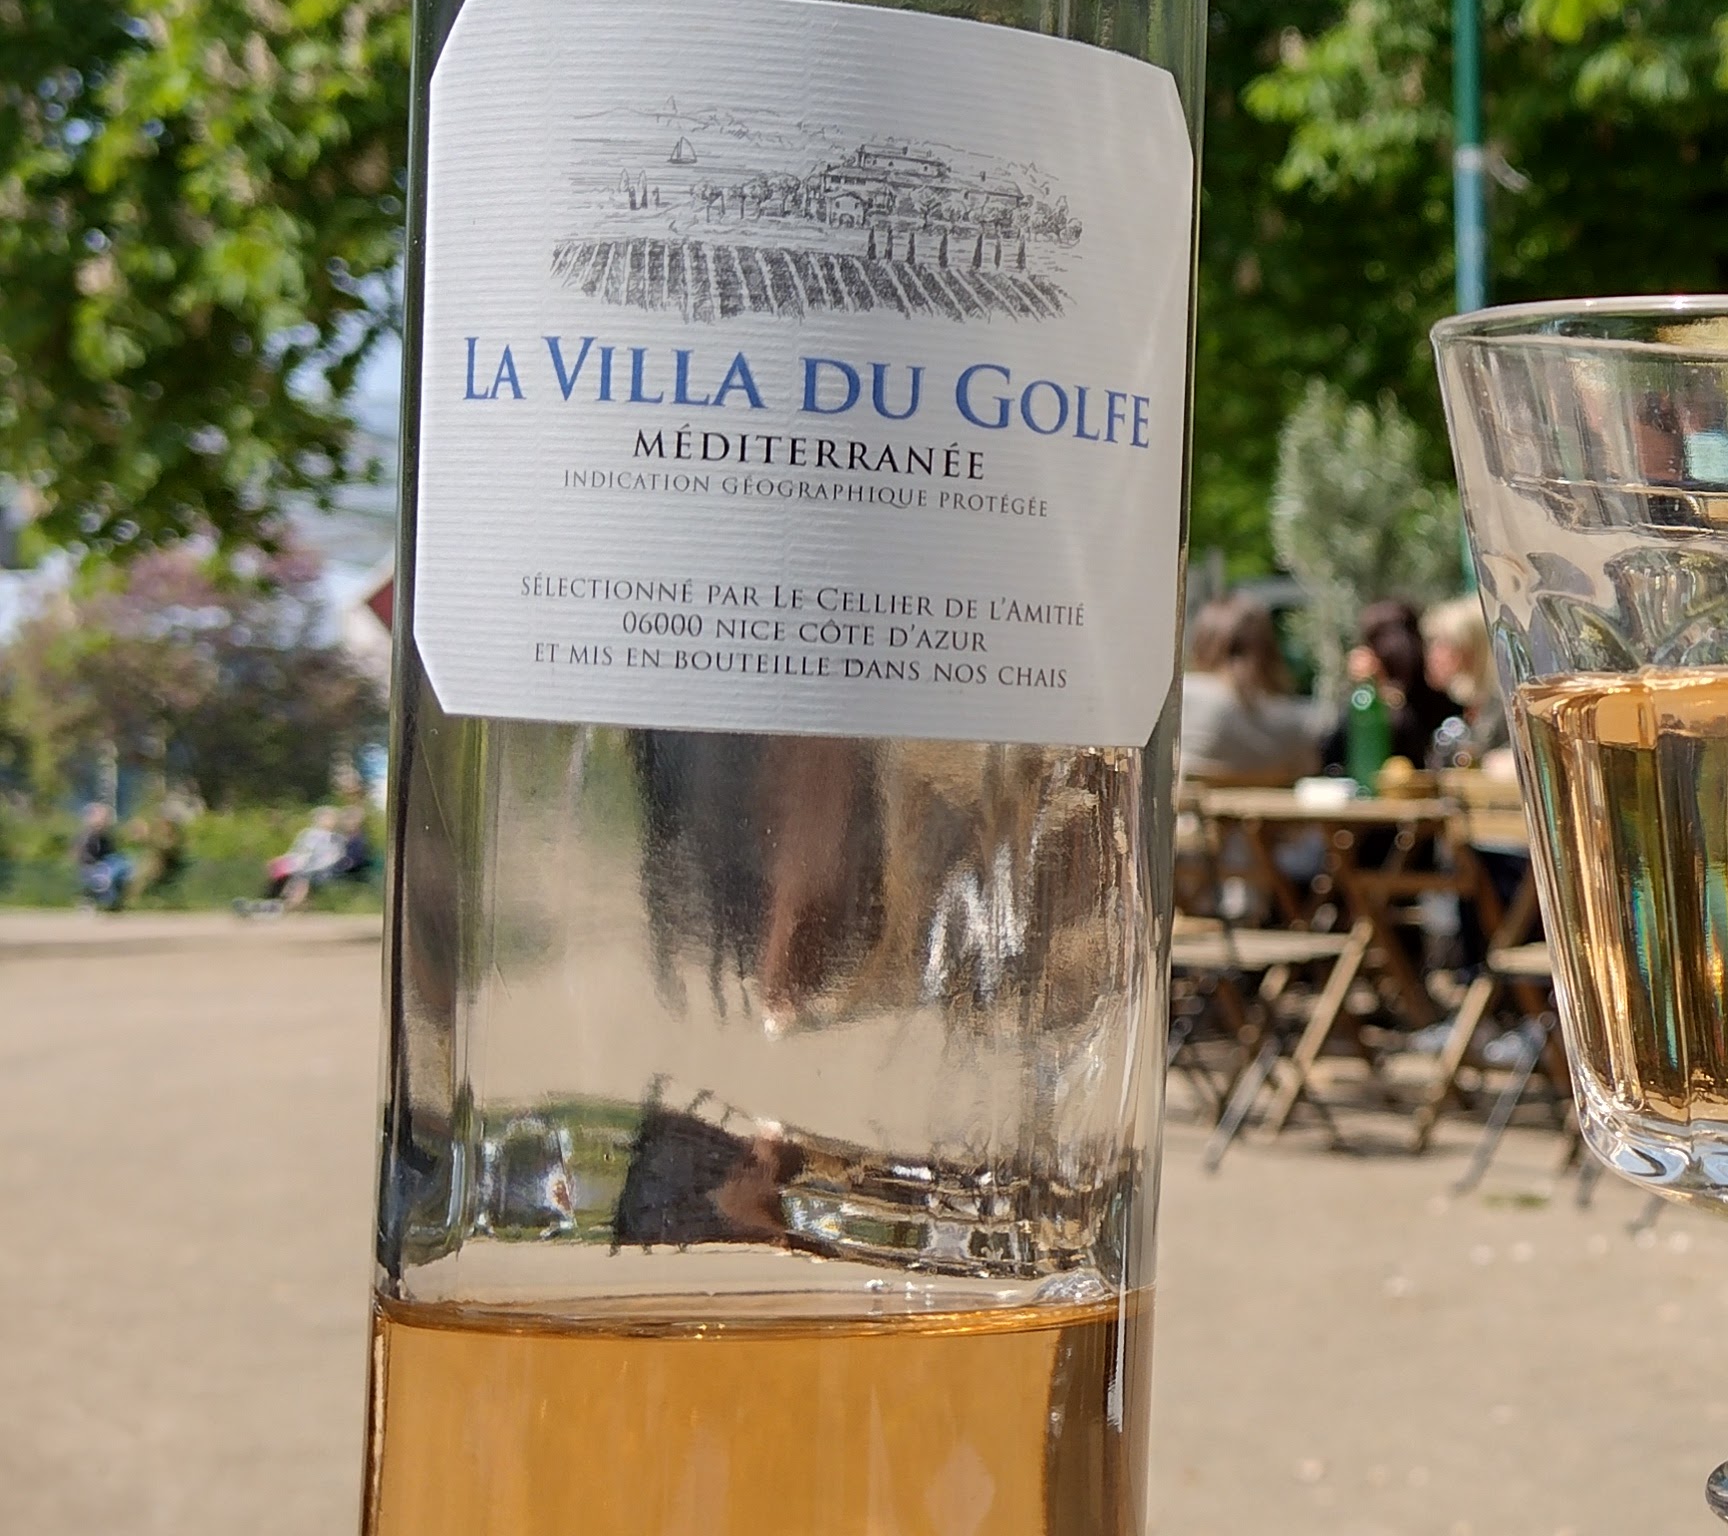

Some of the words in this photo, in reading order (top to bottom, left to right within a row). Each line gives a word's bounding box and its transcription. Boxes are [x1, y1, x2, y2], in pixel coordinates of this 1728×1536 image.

[463, 336, 524, 401] LA
[540, 335, 768, 410] VILLA
[799, 356, 926, 421] DU
[955, 363, 1150, 449] GOLFE
[632, 423, 985, 481] MÉDITERRANÉE
[564, 469, 710, 493] INDICATION
[721, 474, 928, 510] GÉOGRAPHIQUE
[939, 491, 1049, 518] PROTÉGÉE
[521, 571, 693, 604] SÉLECTIONNÉ
[708, 584, 760, 607] PAR
[816, 587, 934, 617] CELLIER
[945, 597, 977, 620] DE
[622, 610, 703, 638] 06000
[715, 618, 786, 642] NICE
[798, 617, 876, 647] CÔTE
[888, 623, 988, 654] D'AZUR
[535, 642, 560, 664] ET
[569, 644, 613, 666] MIS
[626, 647, 661, 669] EN
[674, 649, 831, 678] BOUTEILLE
[844, 657, 920, 682] DANS
[933, 662, 988, 685] NOS
[997, 665, 1068, 690] CHAIS
